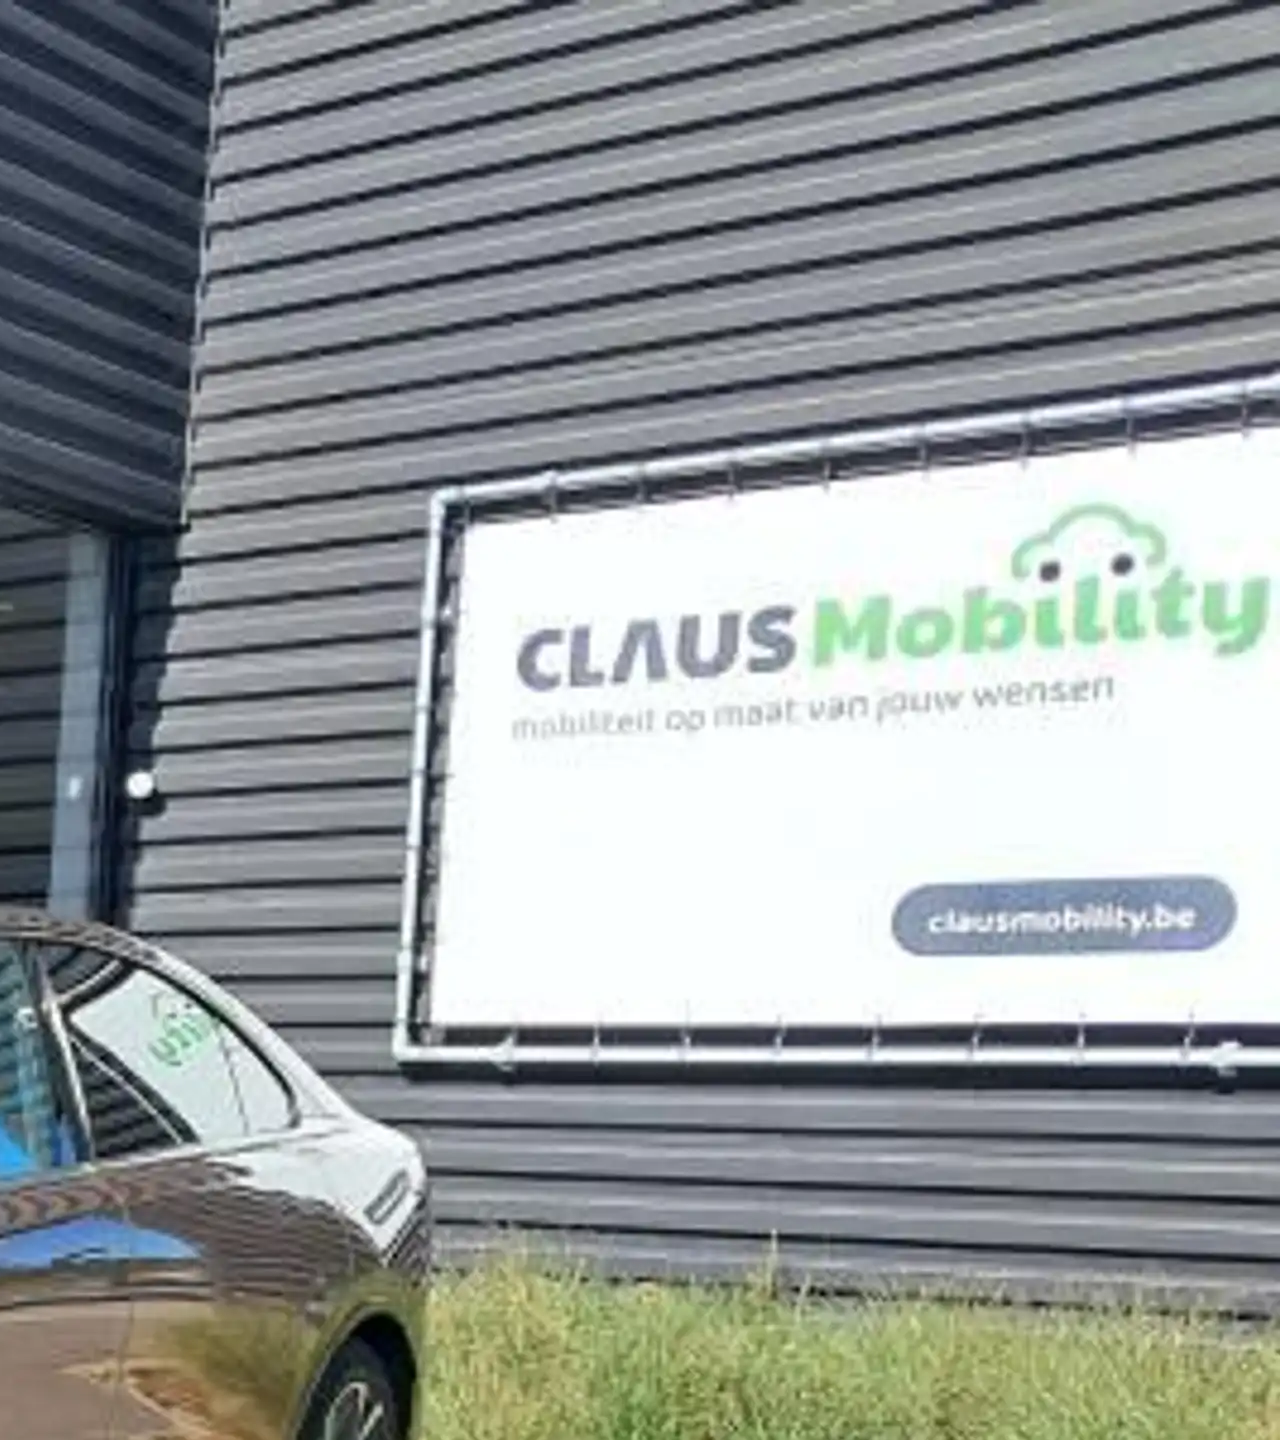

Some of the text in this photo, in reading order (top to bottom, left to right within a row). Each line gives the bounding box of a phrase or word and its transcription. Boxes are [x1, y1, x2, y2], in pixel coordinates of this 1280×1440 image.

[517, 566, 1270, 692] CLAUS Mobility
[512, 675, 1114, 740] mobiliteit op maat van jouw wensen
[928, 901, 1196, 938] clausmobility.be
